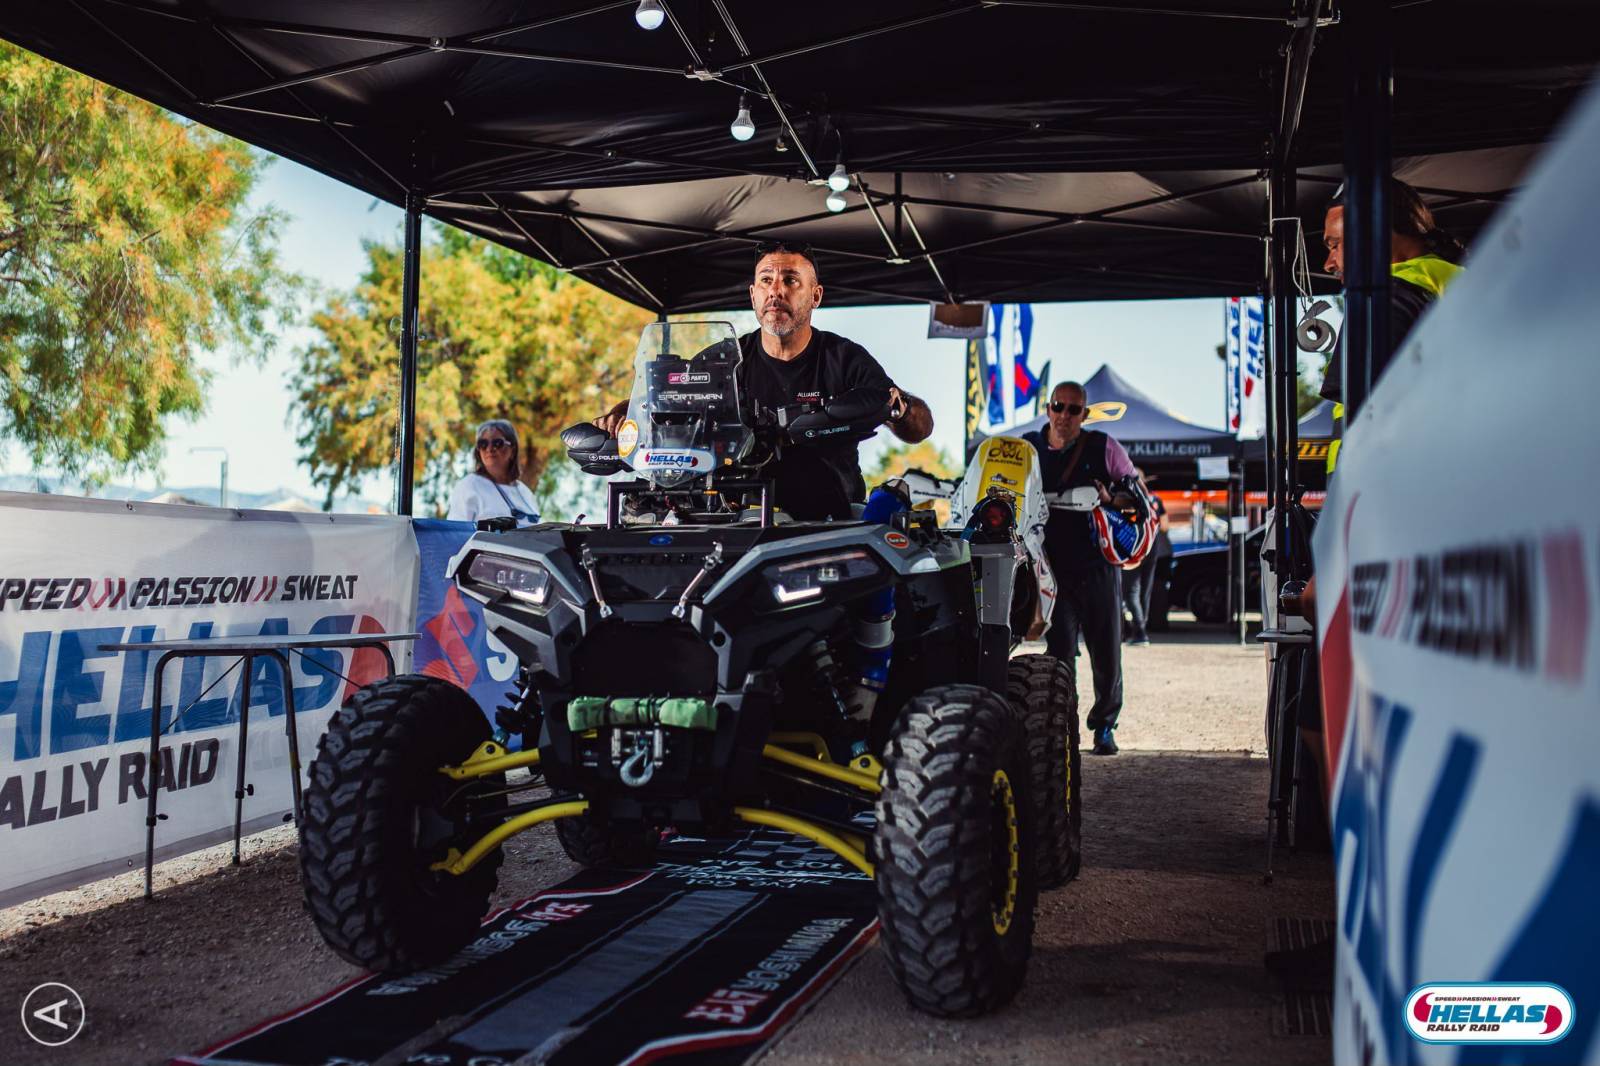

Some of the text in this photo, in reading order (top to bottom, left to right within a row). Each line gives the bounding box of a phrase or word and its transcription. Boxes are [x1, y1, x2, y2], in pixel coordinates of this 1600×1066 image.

[658, 393, 723, 401] SPORTSMAN
[649, 455, 693, 463] HELLAS
[0, 575, 358, 611] PEED PASSION SWEAT
[119, 737, 220, 805] RAID
